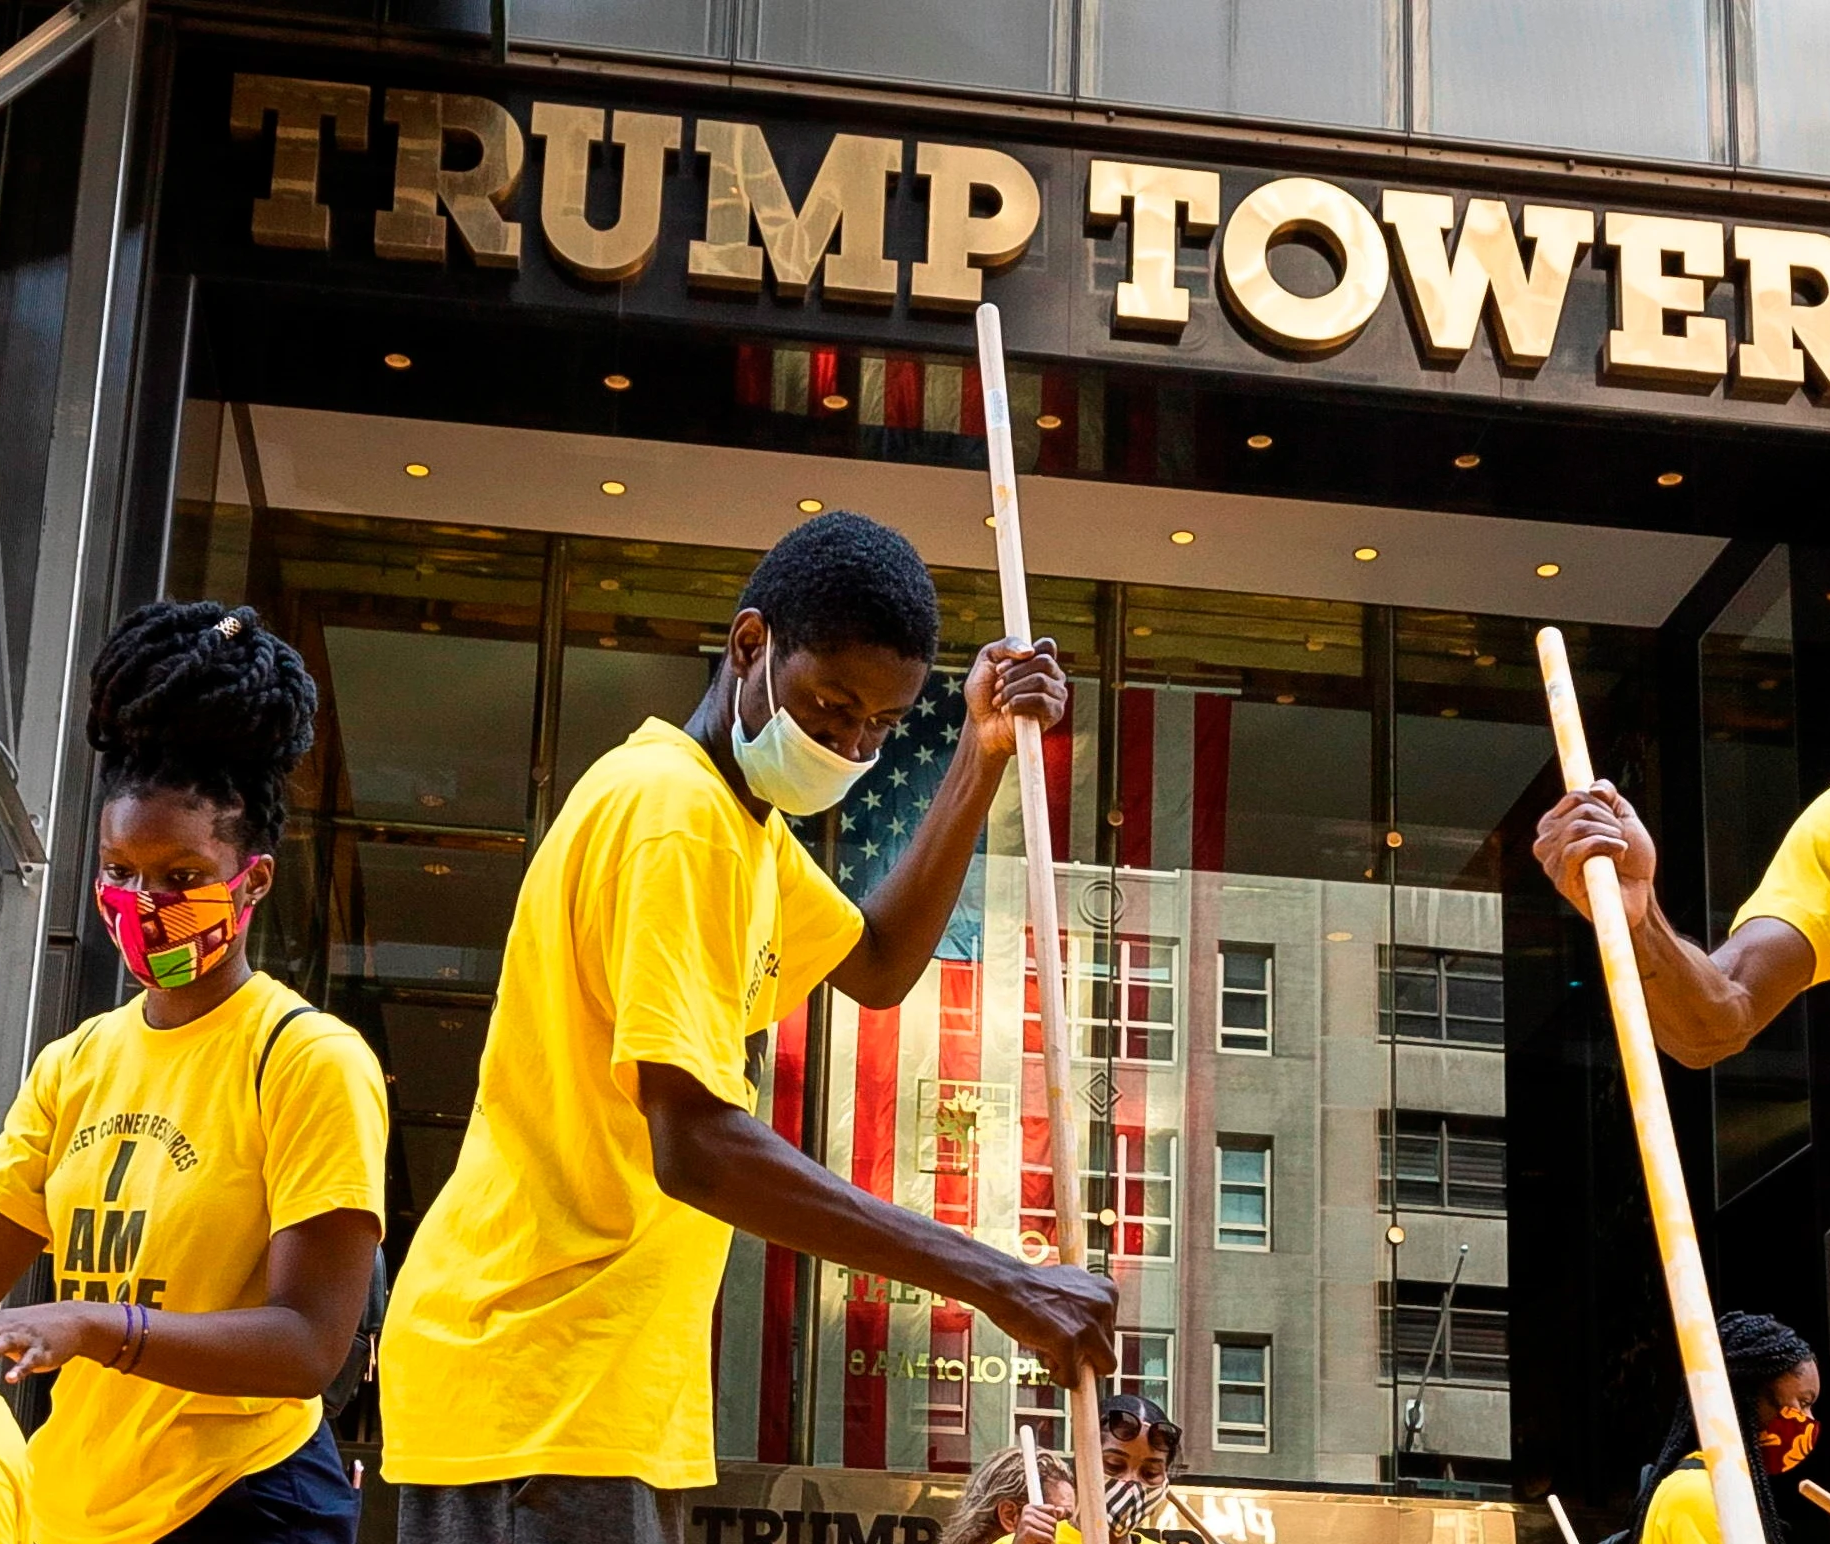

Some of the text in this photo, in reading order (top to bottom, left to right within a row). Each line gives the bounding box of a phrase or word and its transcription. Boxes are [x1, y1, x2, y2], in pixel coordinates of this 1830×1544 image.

[229, 71, 1041, 312] TRUMP
[99, 1113, 150, 1140] CORNER
[147, 1115, 199, 1173] RESRCES
[103, 1140, 138, 1203] I
[64, 1207, 147, 1274] AM
[838, 1267, 920, 1304] THE
[849, 1350, 866, 1376] 8
[935, 1356, 967, 1382] to
[969, 1355, 1007, 1384] 10
